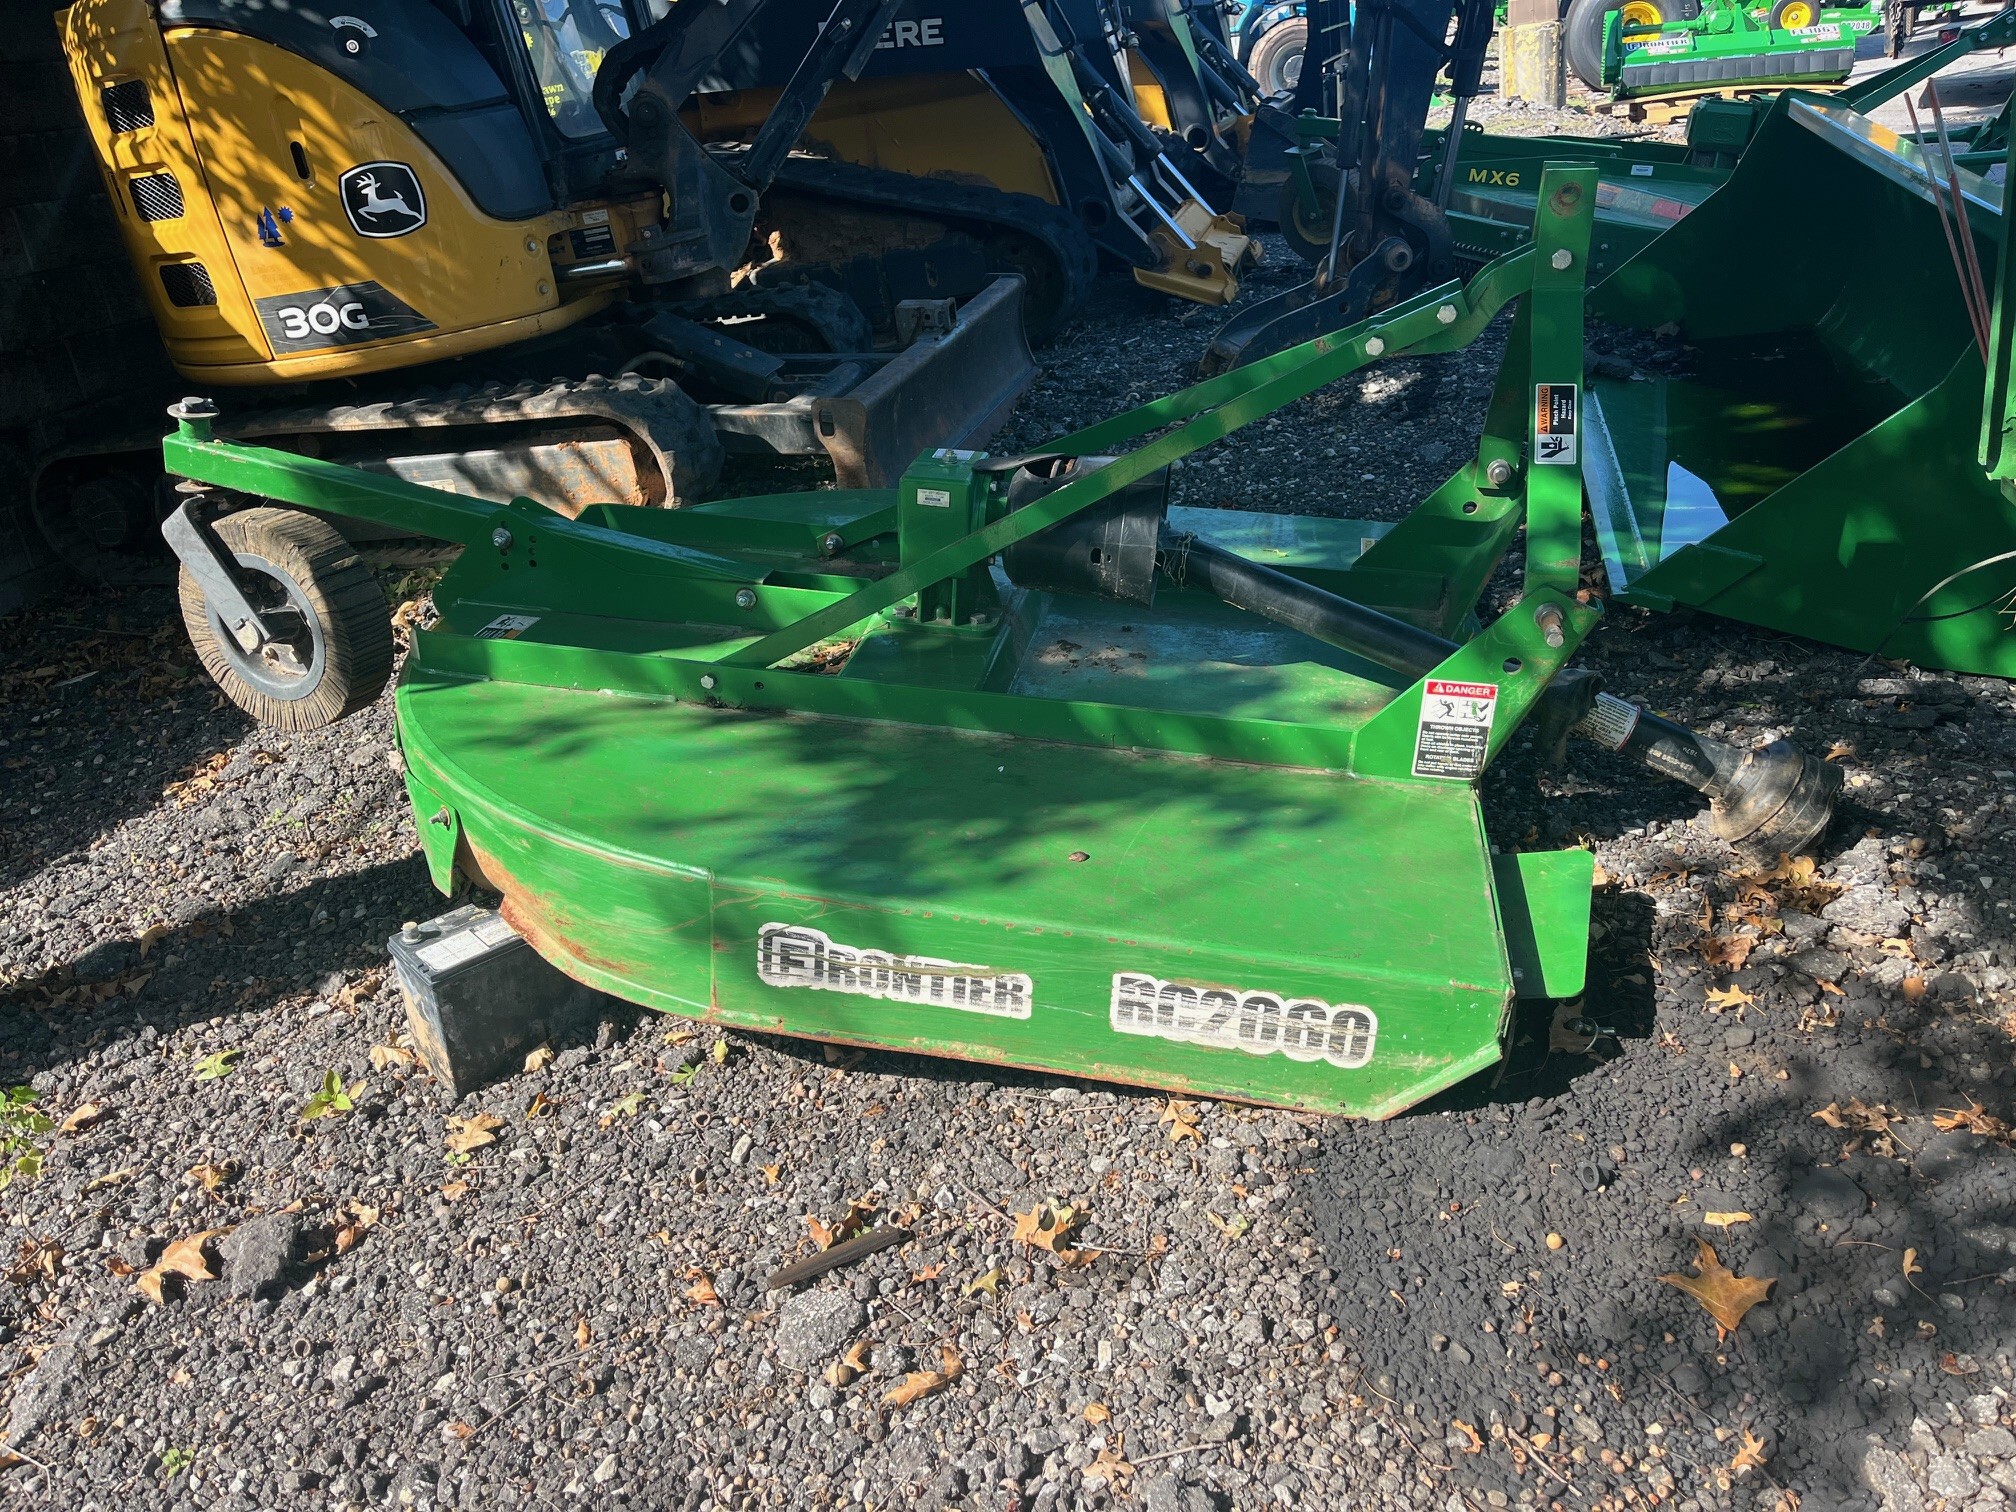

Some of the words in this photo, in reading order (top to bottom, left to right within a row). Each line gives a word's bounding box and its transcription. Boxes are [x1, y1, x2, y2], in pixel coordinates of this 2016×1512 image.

[818, 18, 944, 49] ERE
[1468, 168, 1520, 187] MX6
[277, 302, 370, 338] 30G
[1541, 388, 1549, 424] WARNING
[1446, 685, 1491, 696] DANGER
[762, 928, 1024, 1014] FRONTIER
